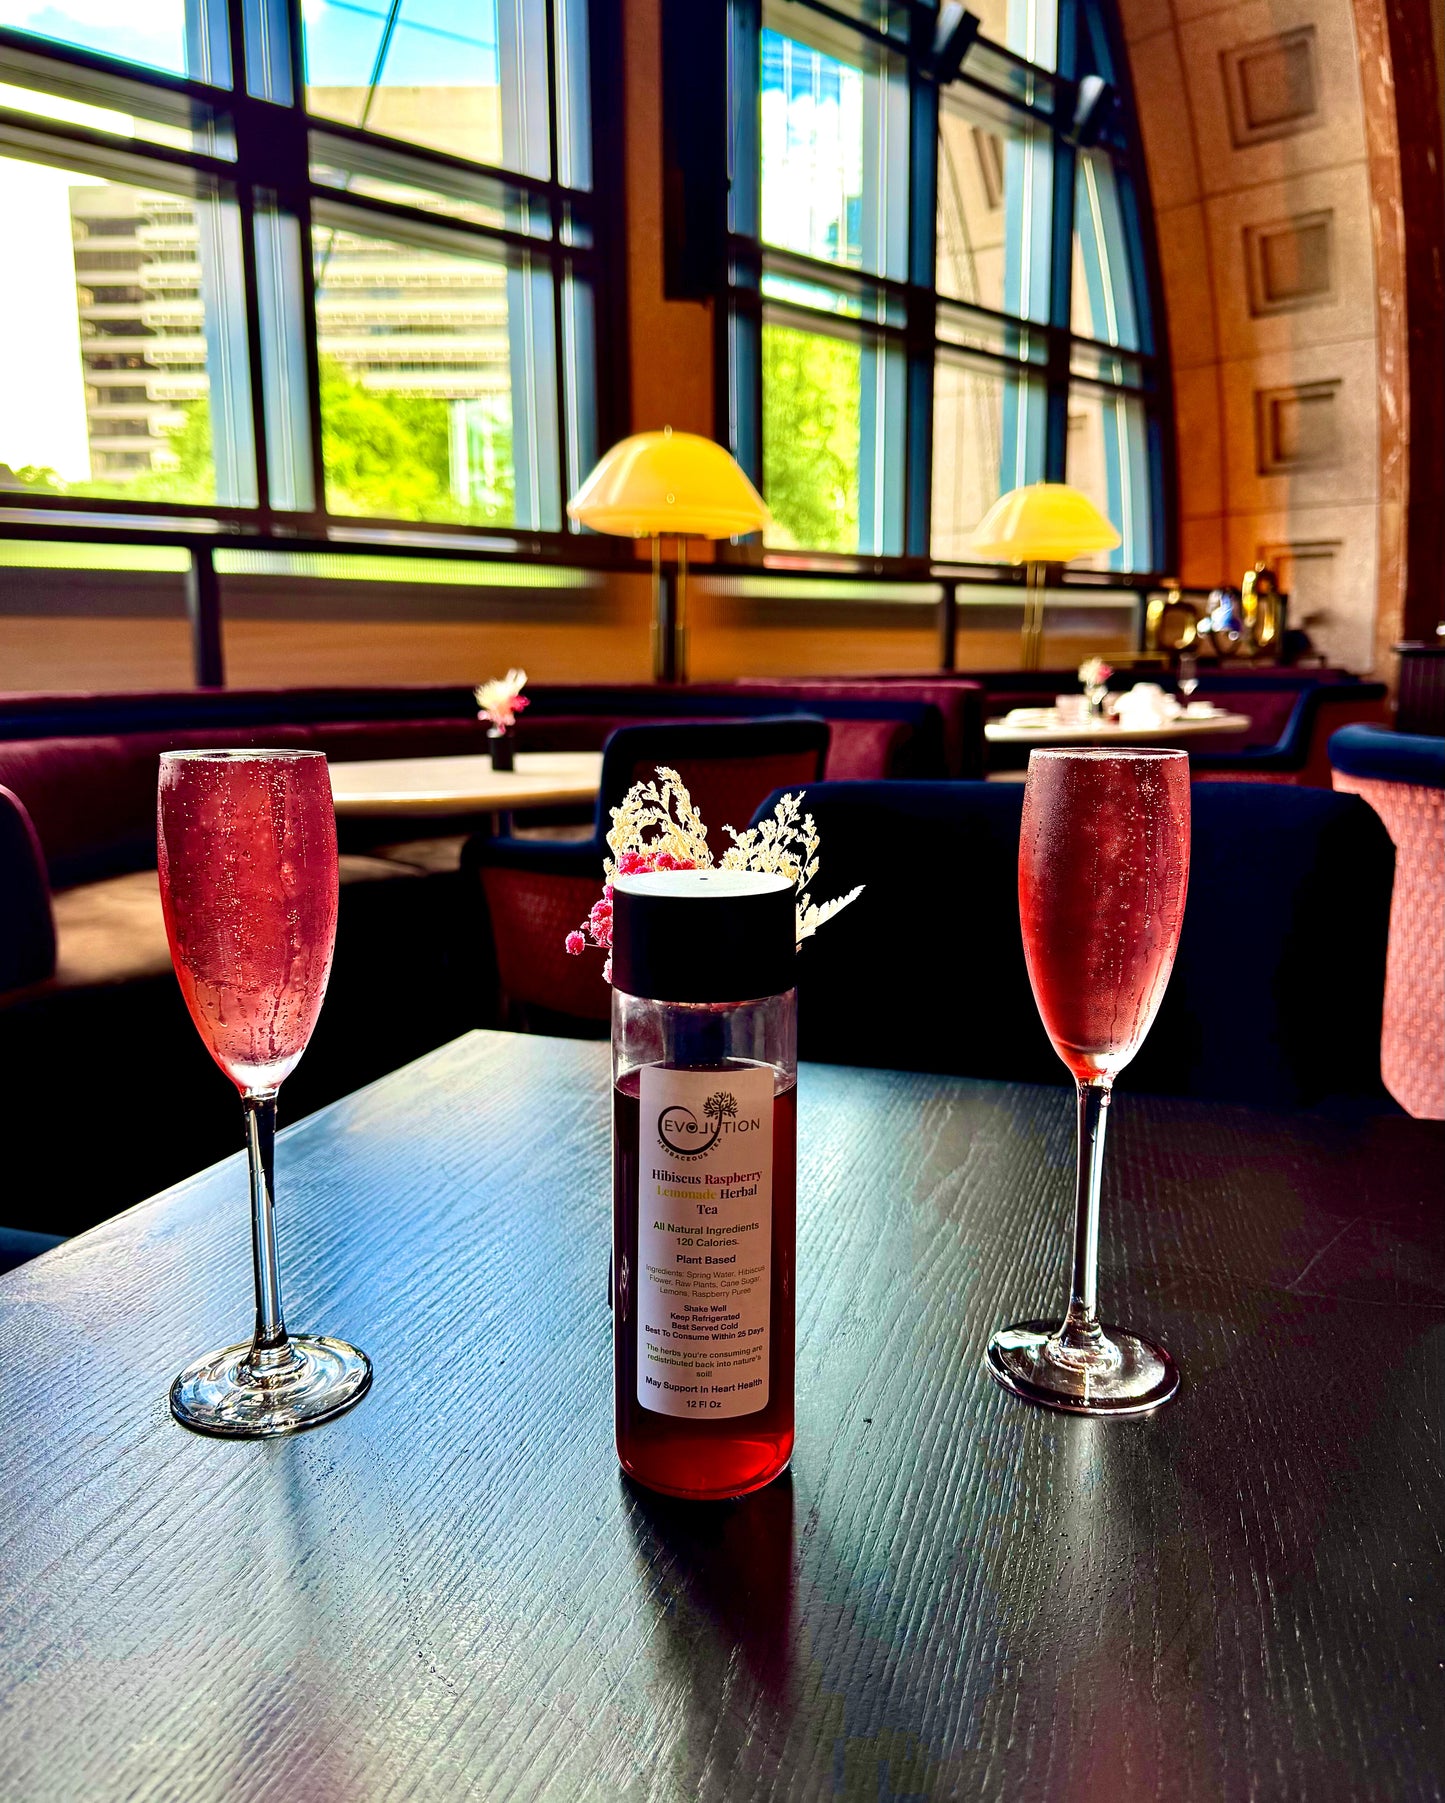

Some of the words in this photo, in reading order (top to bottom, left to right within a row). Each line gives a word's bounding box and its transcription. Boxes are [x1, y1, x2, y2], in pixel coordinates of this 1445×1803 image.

[709, 1137, 722, 1151] TEA
[652, 1169, 702, 1185] Hibiscus
[704, 1170, 762, 1186] Raspberry
[657, 1184, 717, 1200] Lemonade
[720, 1184, 758, 1200] Herbal
[696, 1204, 718, 1215] Tea
[653, 1221, 665, 1231] All
[667, 1222, 704, 1234] Natural
[706, 1221, 760, 1236] Ingredients
[676, 1237, 694, 1247] 120
[696, 1237, 740, 1248] Calories.
[676, 1254, 703, 1264] Plant
[705, 1254, 737, 1265] Based
[646, 1264, 685, 1277] Ingredients:
[686, 1270, 712, 1280] Spring
[738, 1264, 766, 1276] Hibiscus
[675, 1279, 692, 1288] Raw
[720, 1279, 740, 1289] Cane
[692, 1290, 730, 1299] Raspberry
[731, 1286, 752, 1296] Puree
[683, 1304, 709, 1313] Shake
[710, 1304, 727, 1313] Well
[670, 1312, 690, 1322] Keep
[692, 1312, 741, 1324] Refrigerated
[645, 1324, 661, 1336] Best
[662, 1329, 671, 1338] To
[672, 1332, 710, 1342] Consume
[711, 1332, 736, 1341] Within
[737, 1330, 746, 1338] 25
[747, 1326, 765, 1338] Days
[671, 1321, 690, 1331] Best
[691, 1322, 719, 1332] Served
[721, 1321, 739, 1331] Cold
[646, 1342, 659, 1353] The
[660, 1347, 682, 1357] herbs
[683, 1350, 708, 1360] you're
[709, 1347, 751, 1359] consuming
[752, 1344, 763, 1352] are
[647, 1353, 694, 1368] redistributed
[695, 1359, 715, 1368] back
[716, 1359, 732, 1367] into
[645, 1375, 662, 1389] May
[663, 1381, 699, 1394] Support
[700, 1384, 709, 1393] In
[711, 1383, 736, 1393] Heart
[737, 1378, 763, 1391] Health
[686, 1400, 697, 1408] 12
[709, 1400, 722, 1408] Oz
